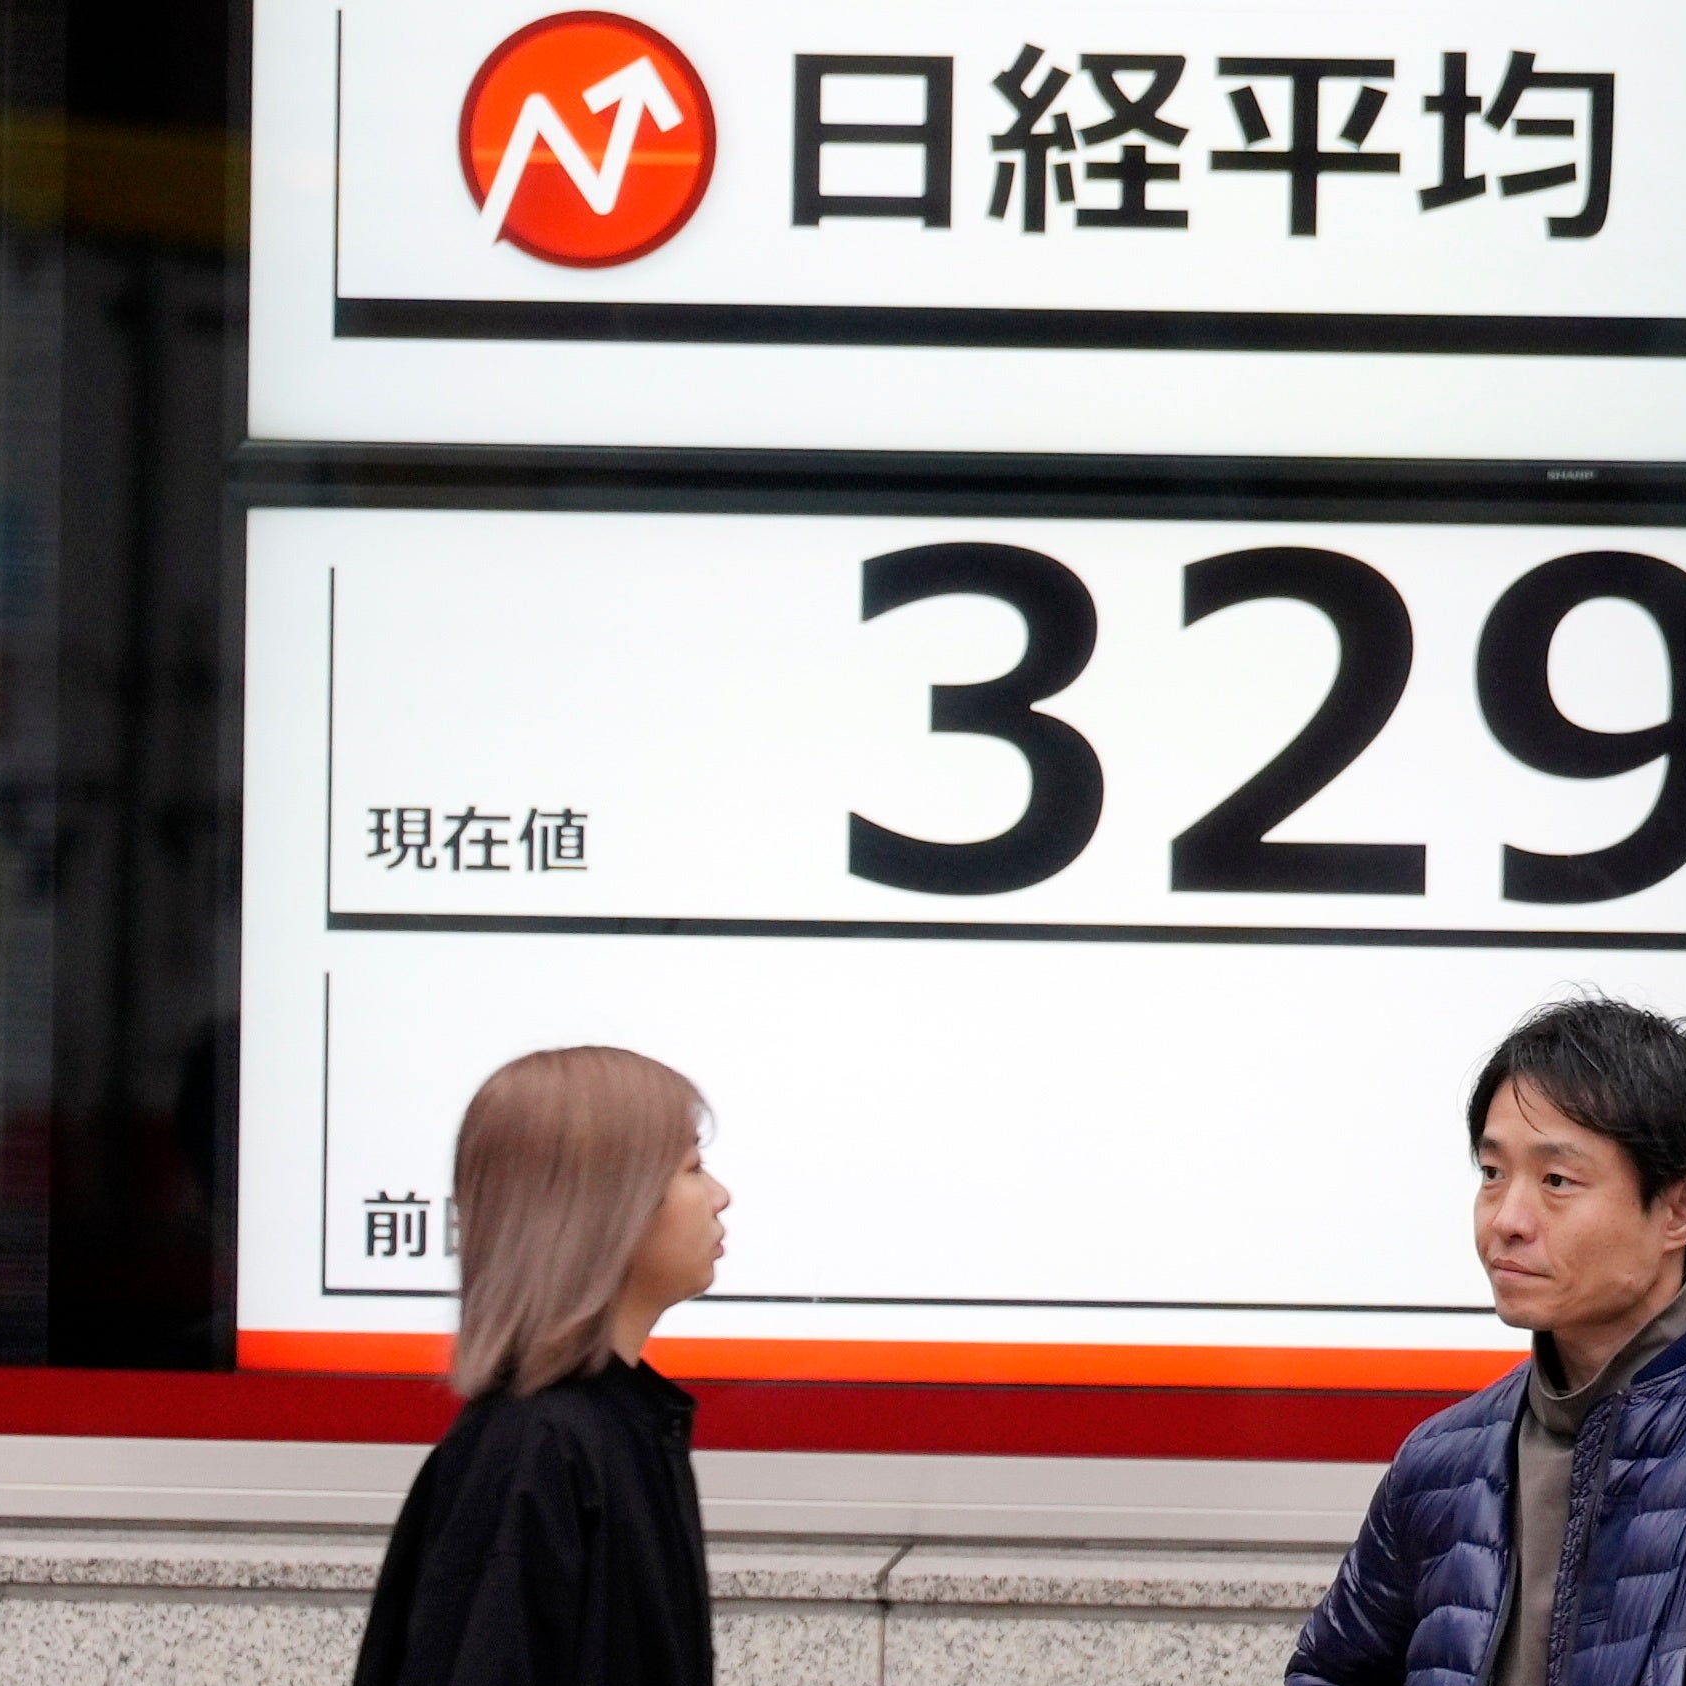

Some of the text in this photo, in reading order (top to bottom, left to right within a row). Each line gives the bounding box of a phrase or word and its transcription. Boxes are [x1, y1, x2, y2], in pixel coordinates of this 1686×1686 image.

[789, 42, 1616, 240] 日経平均
[365, 805, 590, 873] 現在値
